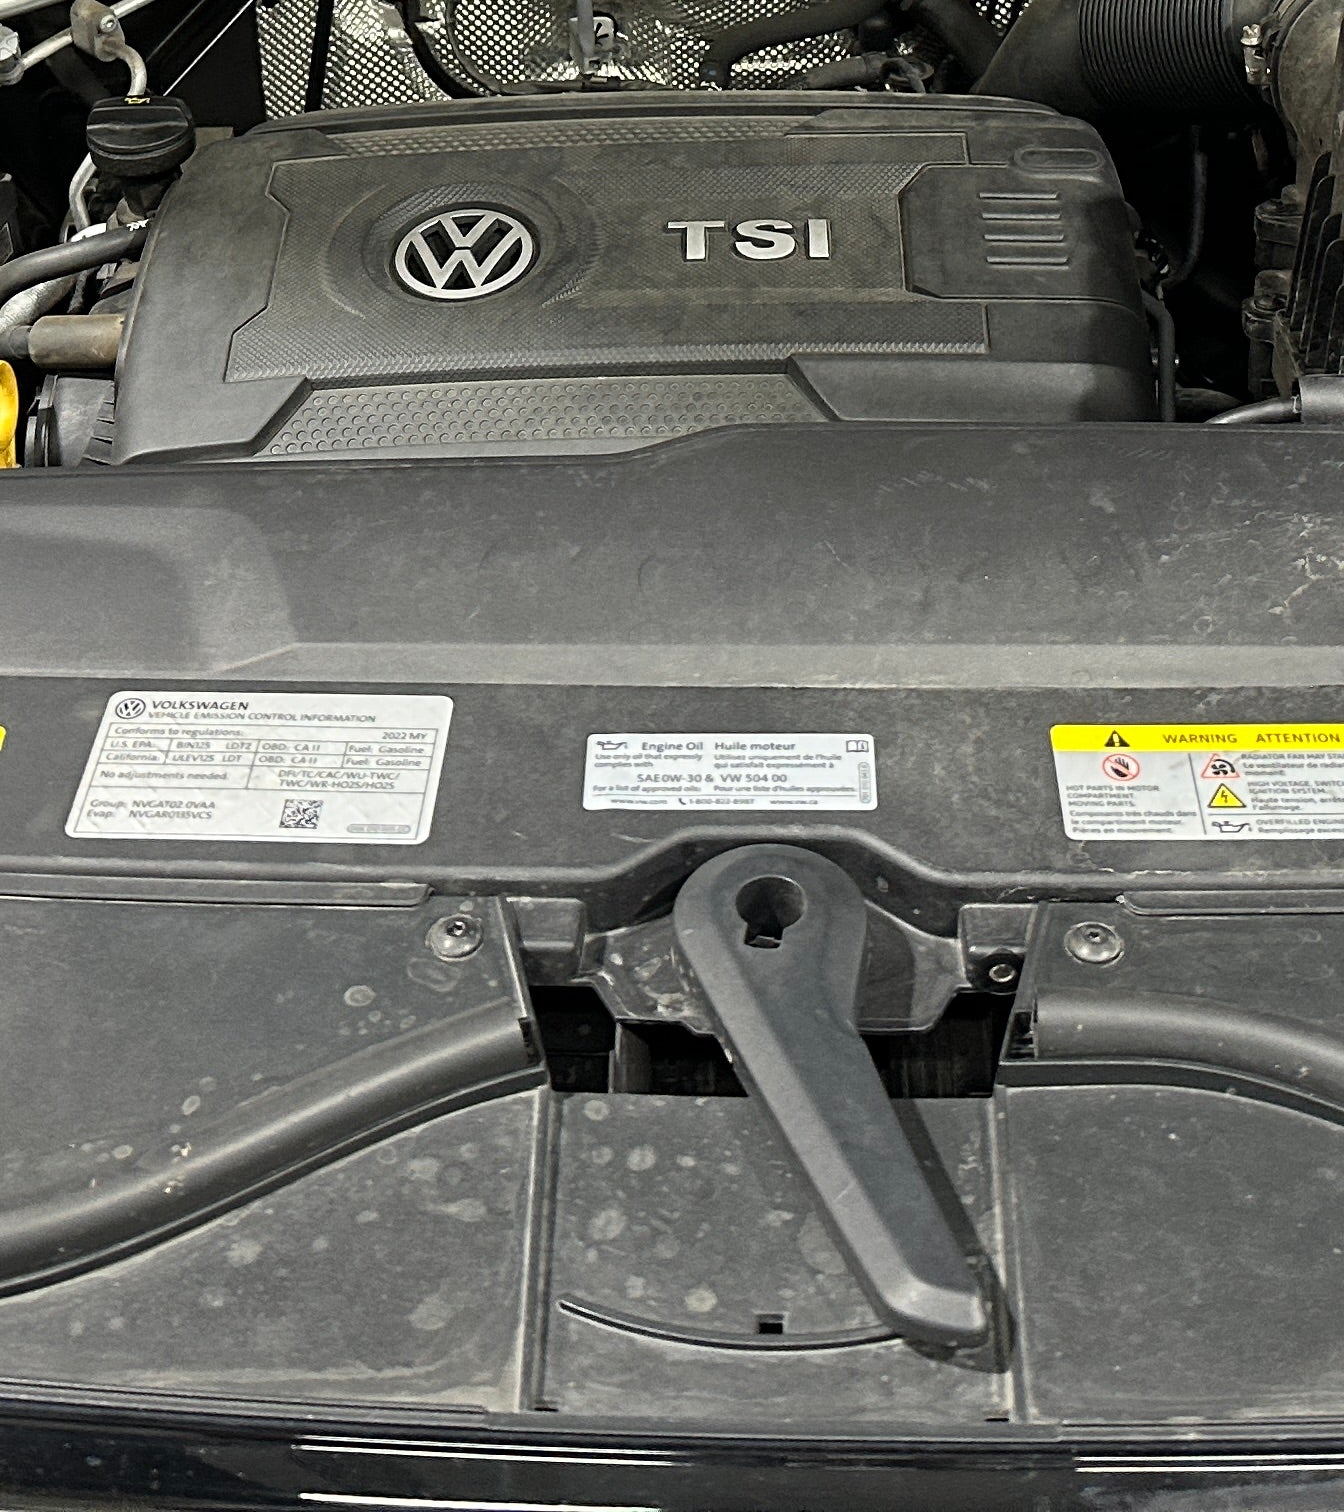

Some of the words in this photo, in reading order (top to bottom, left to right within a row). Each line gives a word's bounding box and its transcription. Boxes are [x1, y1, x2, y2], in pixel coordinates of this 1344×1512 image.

[668, 218, 829, 262] TSI
[150, 700, 249, 710] VOLKSWAGEN
[1162, 733, 1239, 744] WARNING
[1254, 732, 1341, 743] ATTENTION
[641, 741, 682, 752] Engine
[686, 741, 703, 750] Oil
[715, 741, 747, 750] Huile
[749, 741, 795, 750] moteur
